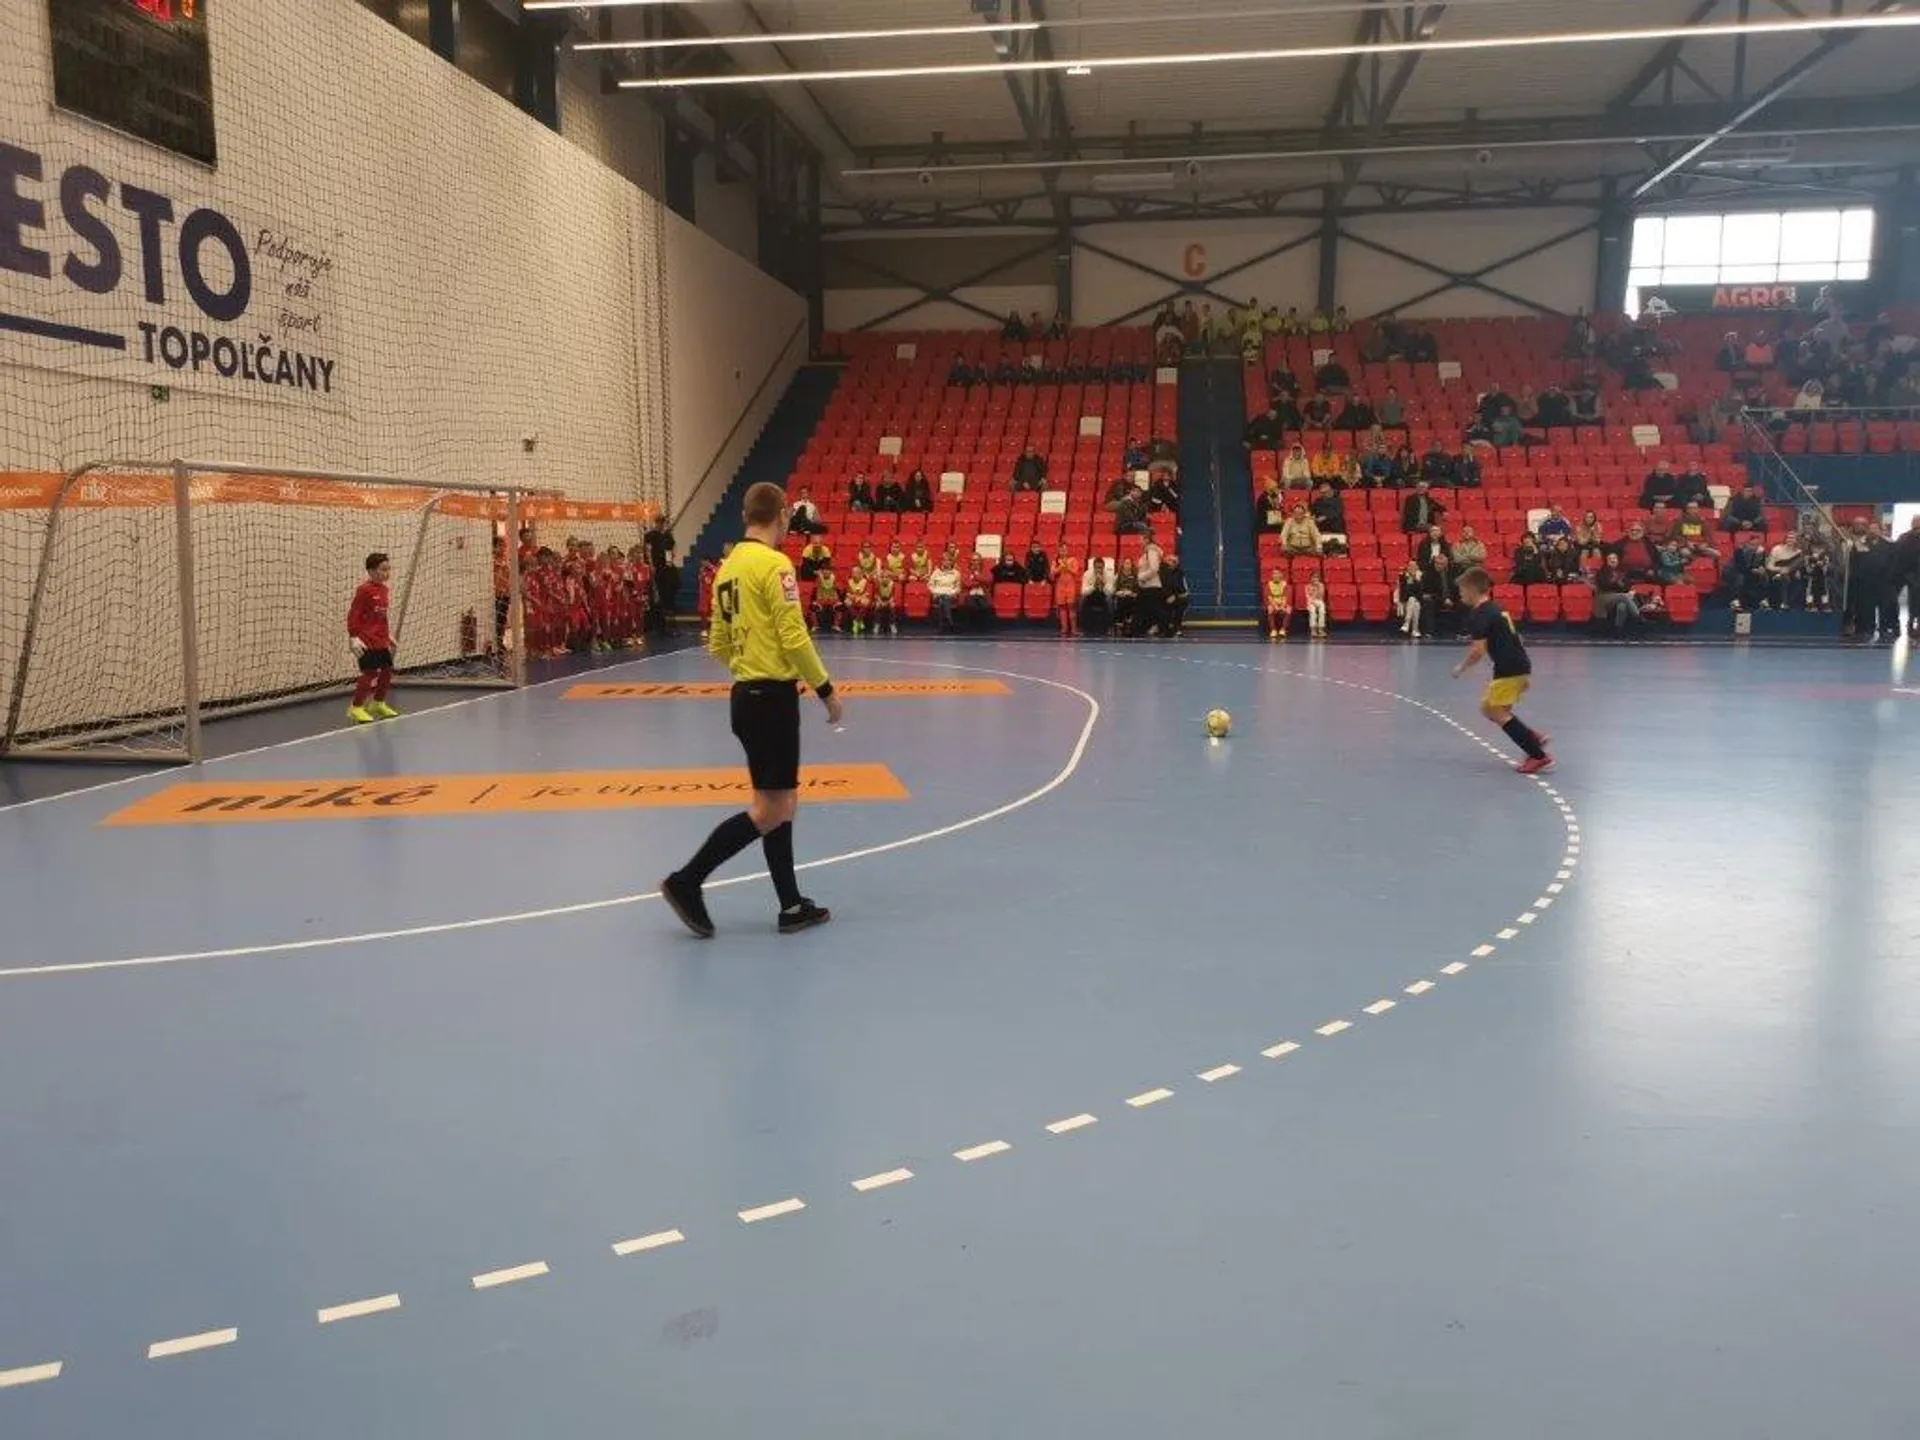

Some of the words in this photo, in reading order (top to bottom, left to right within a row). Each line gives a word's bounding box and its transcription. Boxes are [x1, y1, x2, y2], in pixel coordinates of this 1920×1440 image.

[1183, 243, 1207, 278] C
[138, 320, 335, 393] TOPOĽČANY
[597, 777, 849, 797] tipovie
